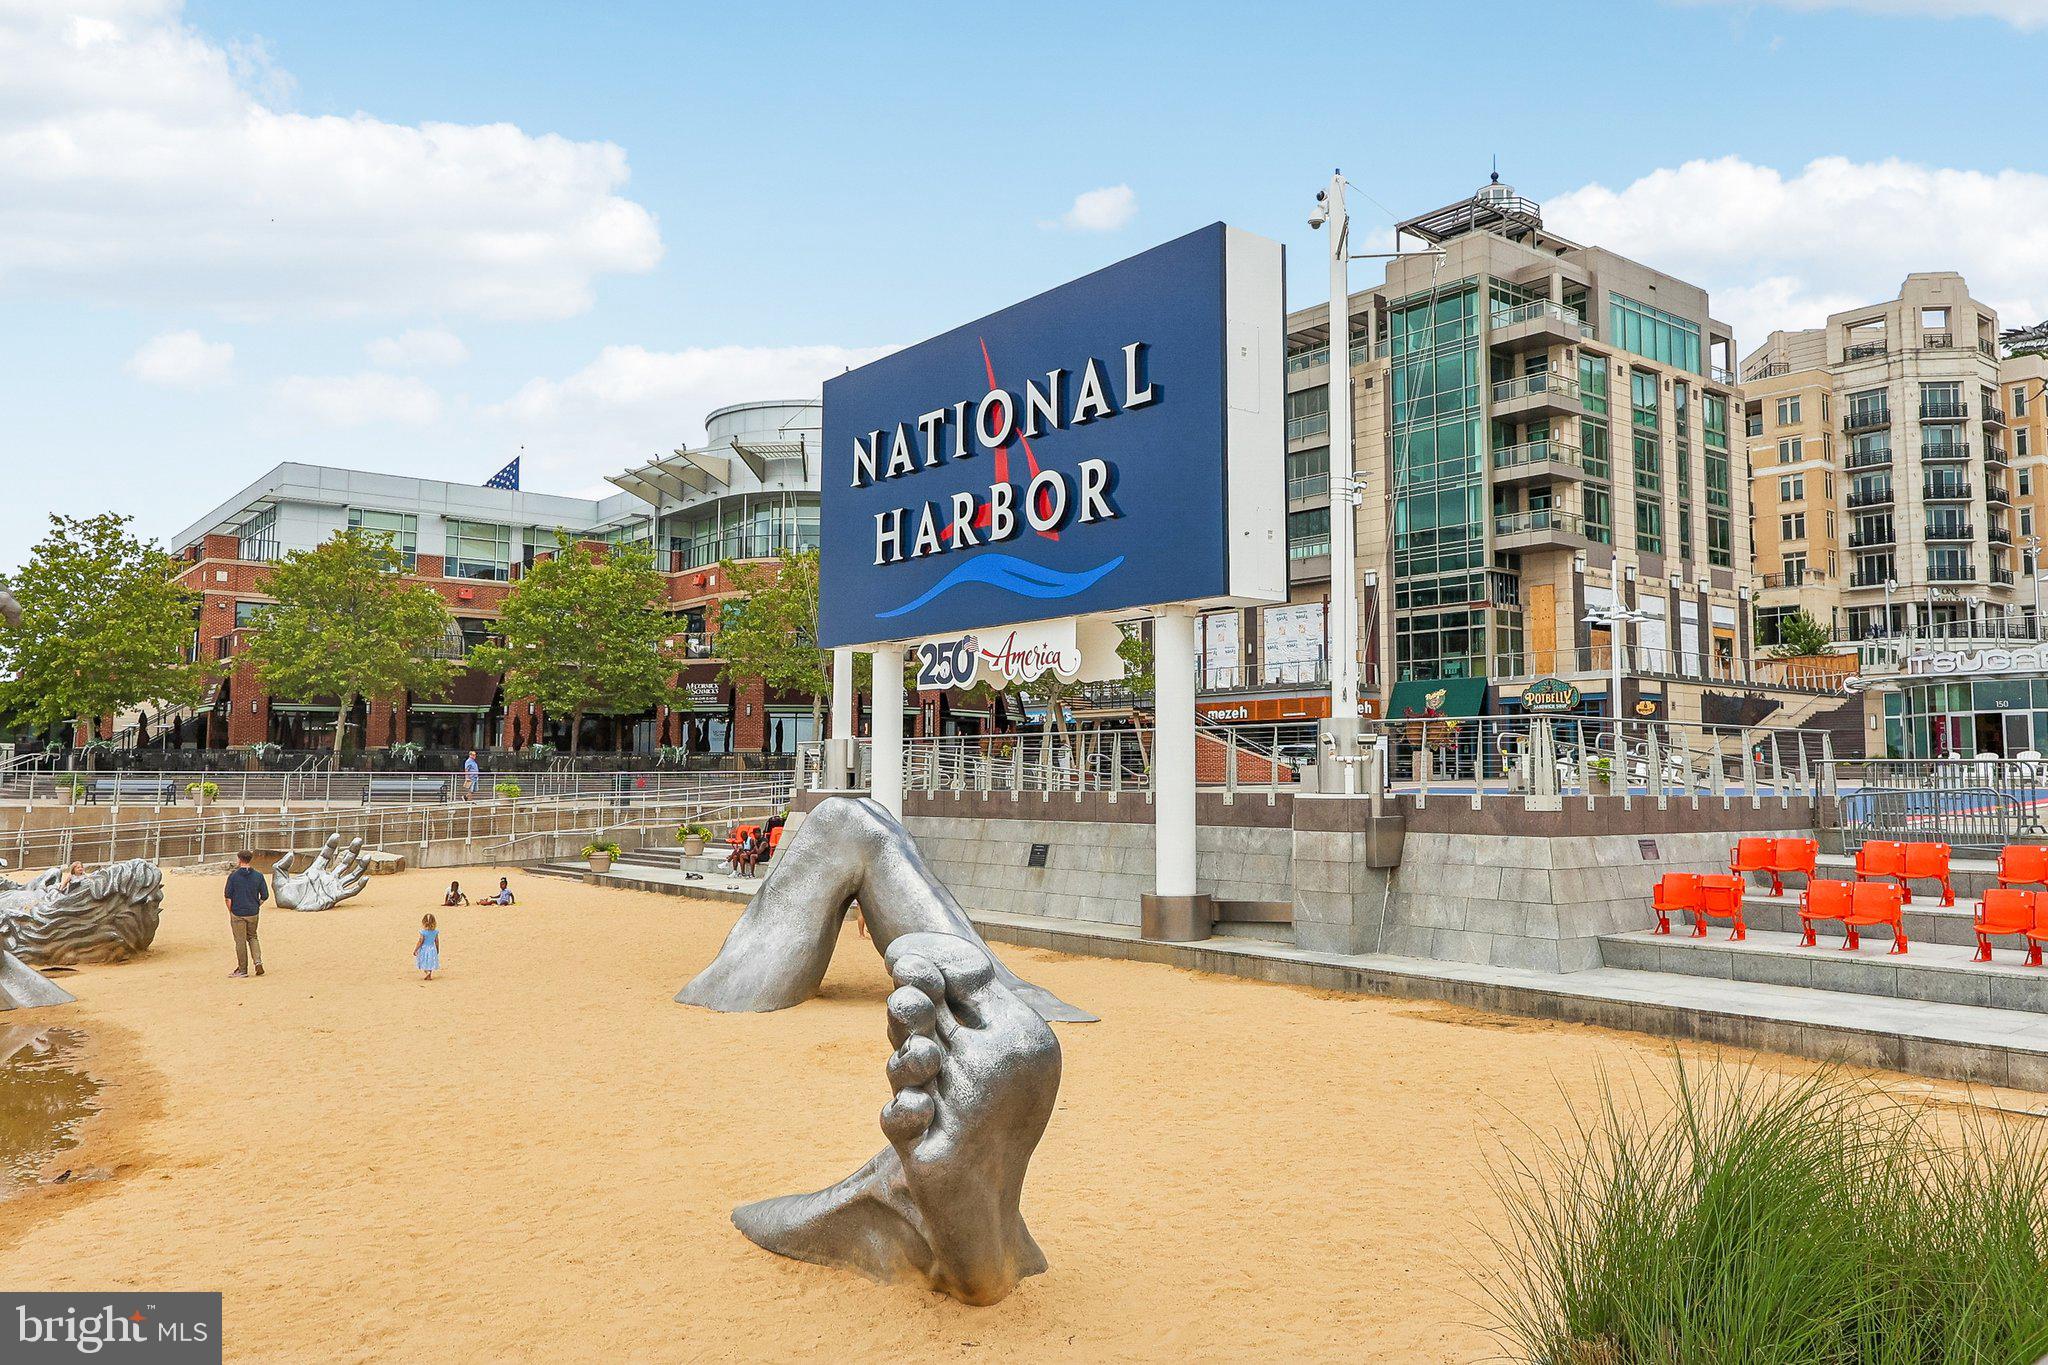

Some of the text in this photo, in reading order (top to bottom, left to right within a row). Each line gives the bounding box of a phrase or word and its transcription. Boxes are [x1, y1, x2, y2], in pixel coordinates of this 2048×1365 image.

[850, 341, 1153, 488] NATIONAL
[873, 458, 1115, 566] HARBOR
[919, 630, 1078, 684] 250 America
[1207, 706, 1248, 720] mezeh
[1525, 689, 1573, 706] POTBELLY
[1995, 700, 2009, 708] 150
